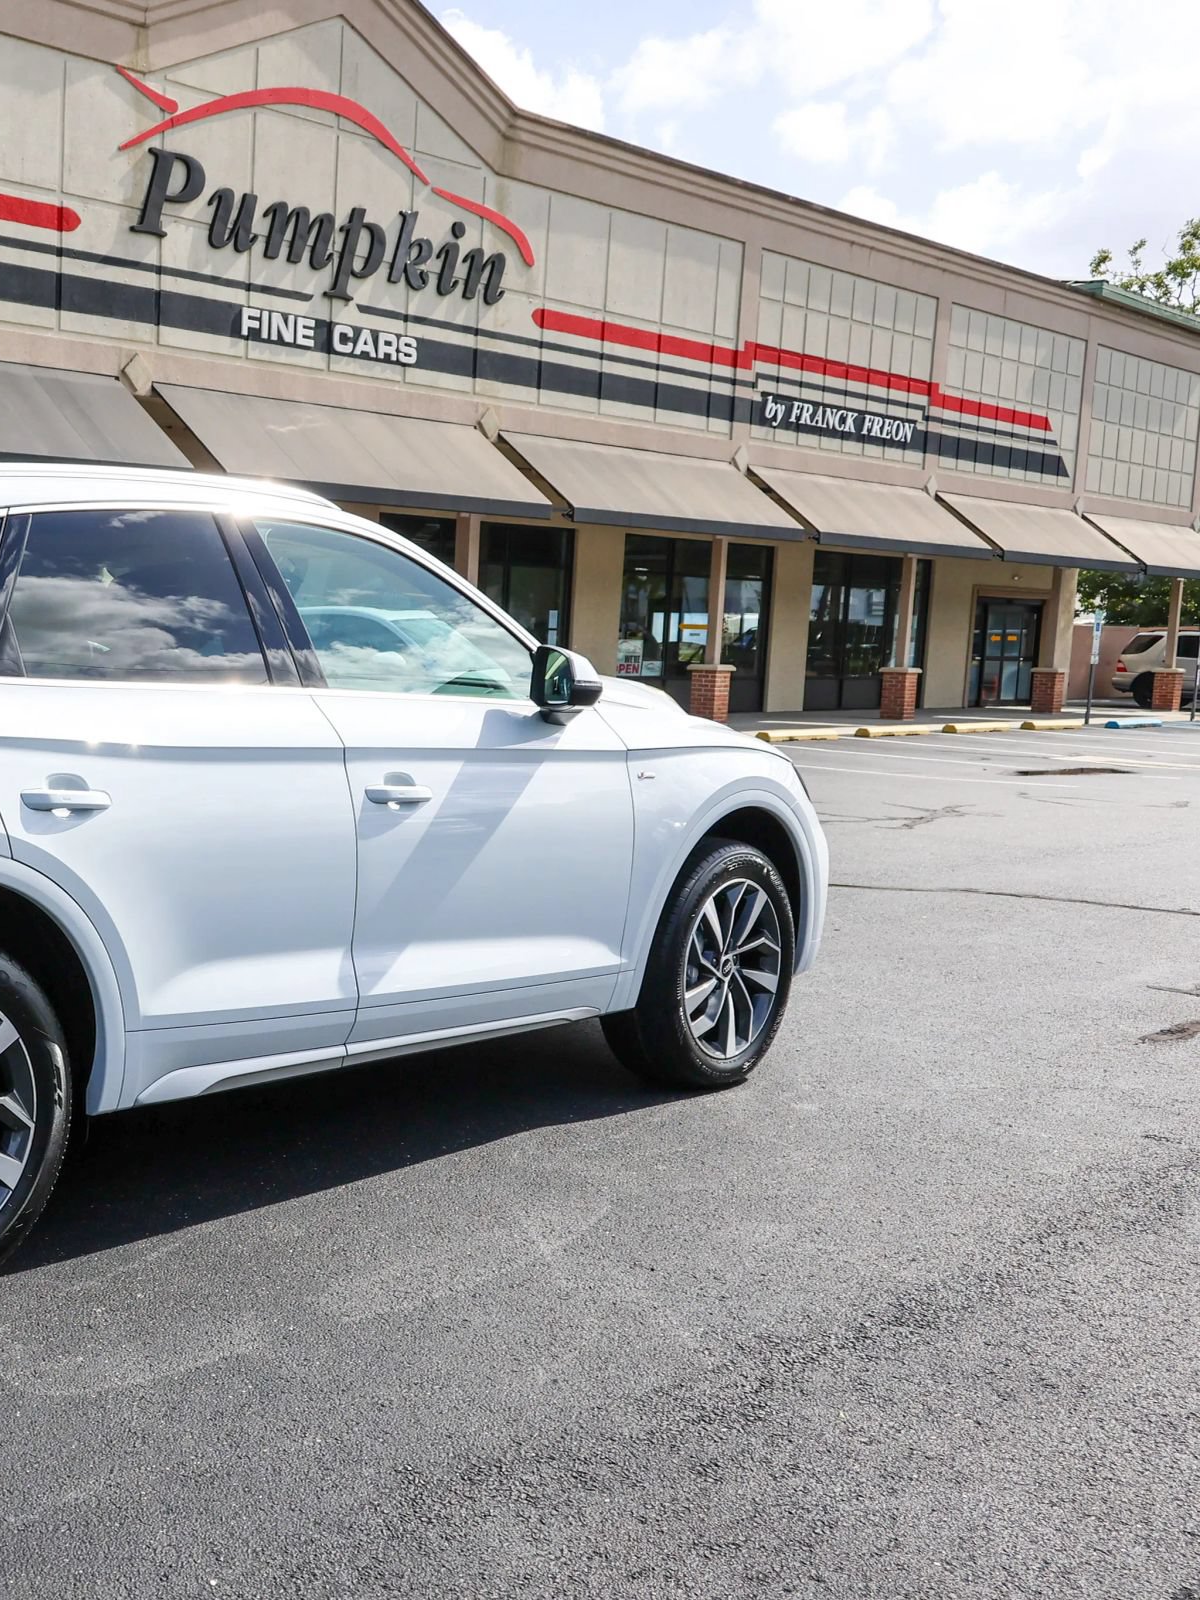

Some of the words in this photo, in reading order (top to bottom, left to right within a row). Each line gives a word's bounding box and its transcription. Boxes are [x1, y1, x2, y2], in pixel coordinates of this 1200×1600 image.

[130, 147, 508, 306] Pumpkin
[241, 306, 315, 348] FINE
[332, 315, 417, 364] CARS
[764, 395, 785, 426] by
[789, 401, 858, 433] FRANCK
[861, 414, 914, 443] FREON
[616, 663, 639, 674] PEN
